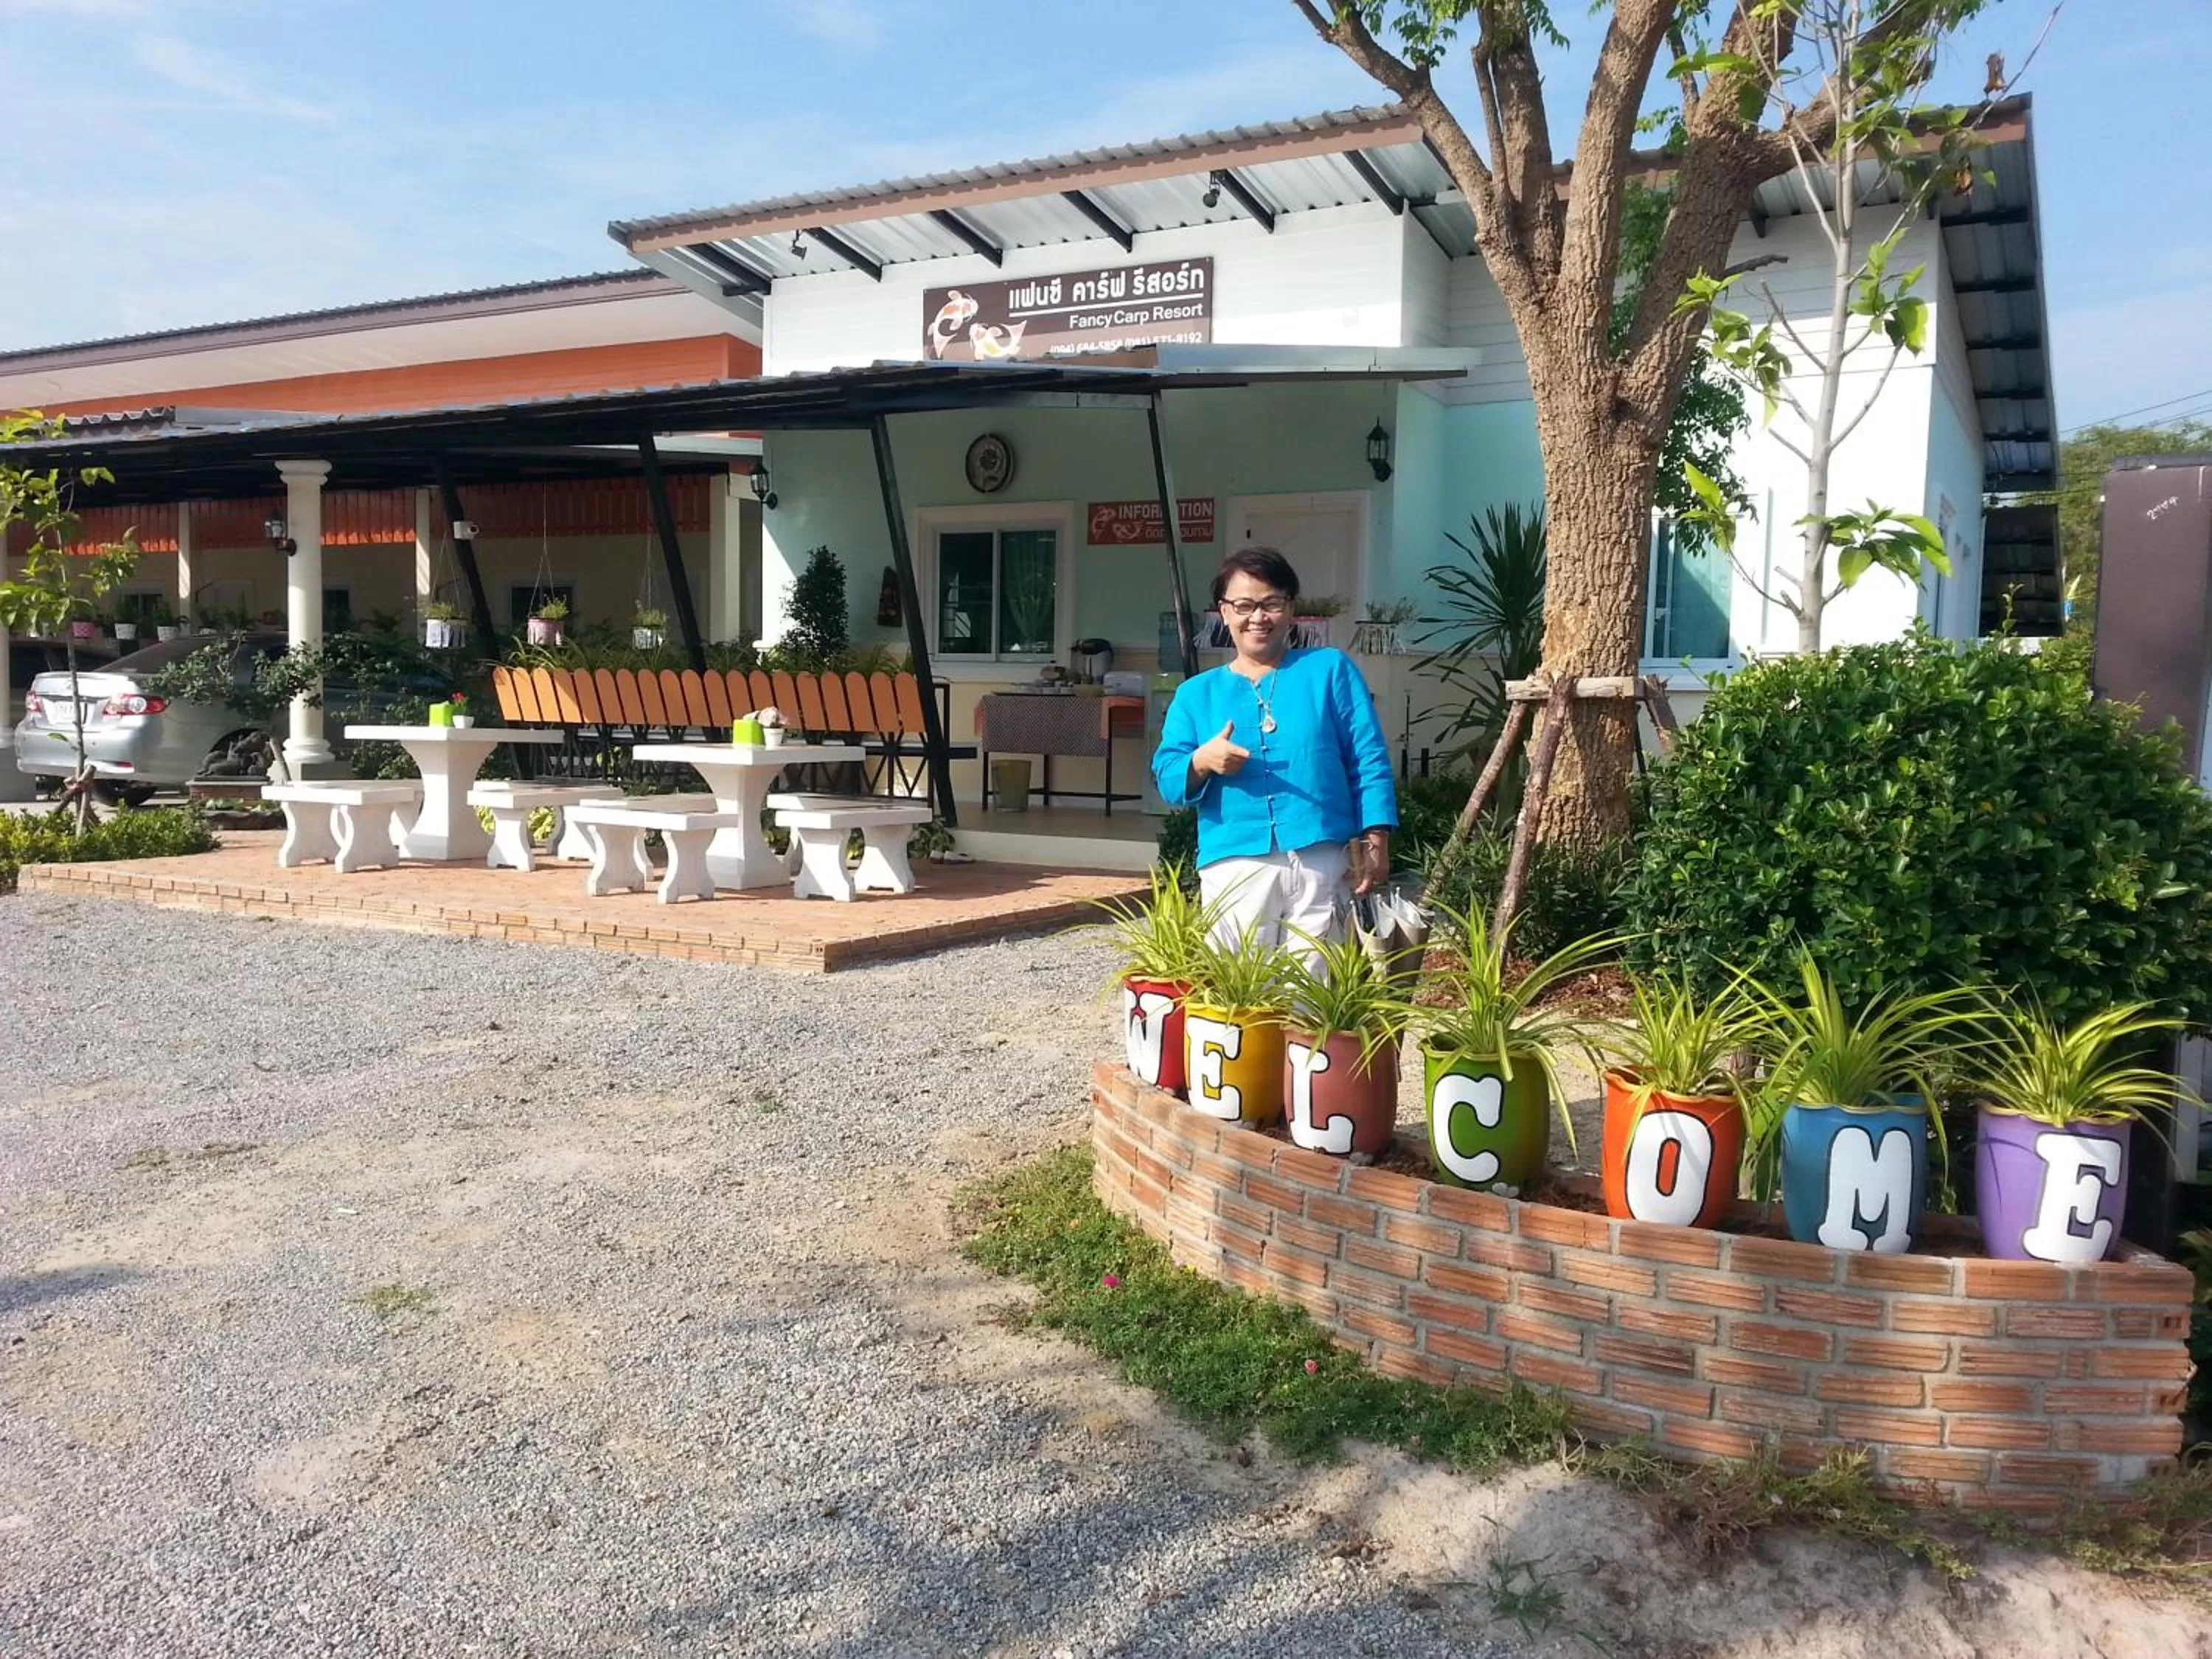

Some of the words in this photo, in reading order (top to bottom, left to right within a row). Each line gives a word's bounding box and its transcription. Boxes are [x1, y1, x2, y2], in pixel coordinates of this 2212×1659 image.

[1073, 271, 1126, 302] คาร์ฟ
[1133, 263, 1204, 295] รีสอร์ท
[1069, 315, 1113, 329] Fancy
[1113, 310, 1150, 325] Carp
[1152, 303, 1203, 320] Resort
[1118, 503, 1213, 519] INFORTION
[1124, 986, 2122, 1264] WELCOME
